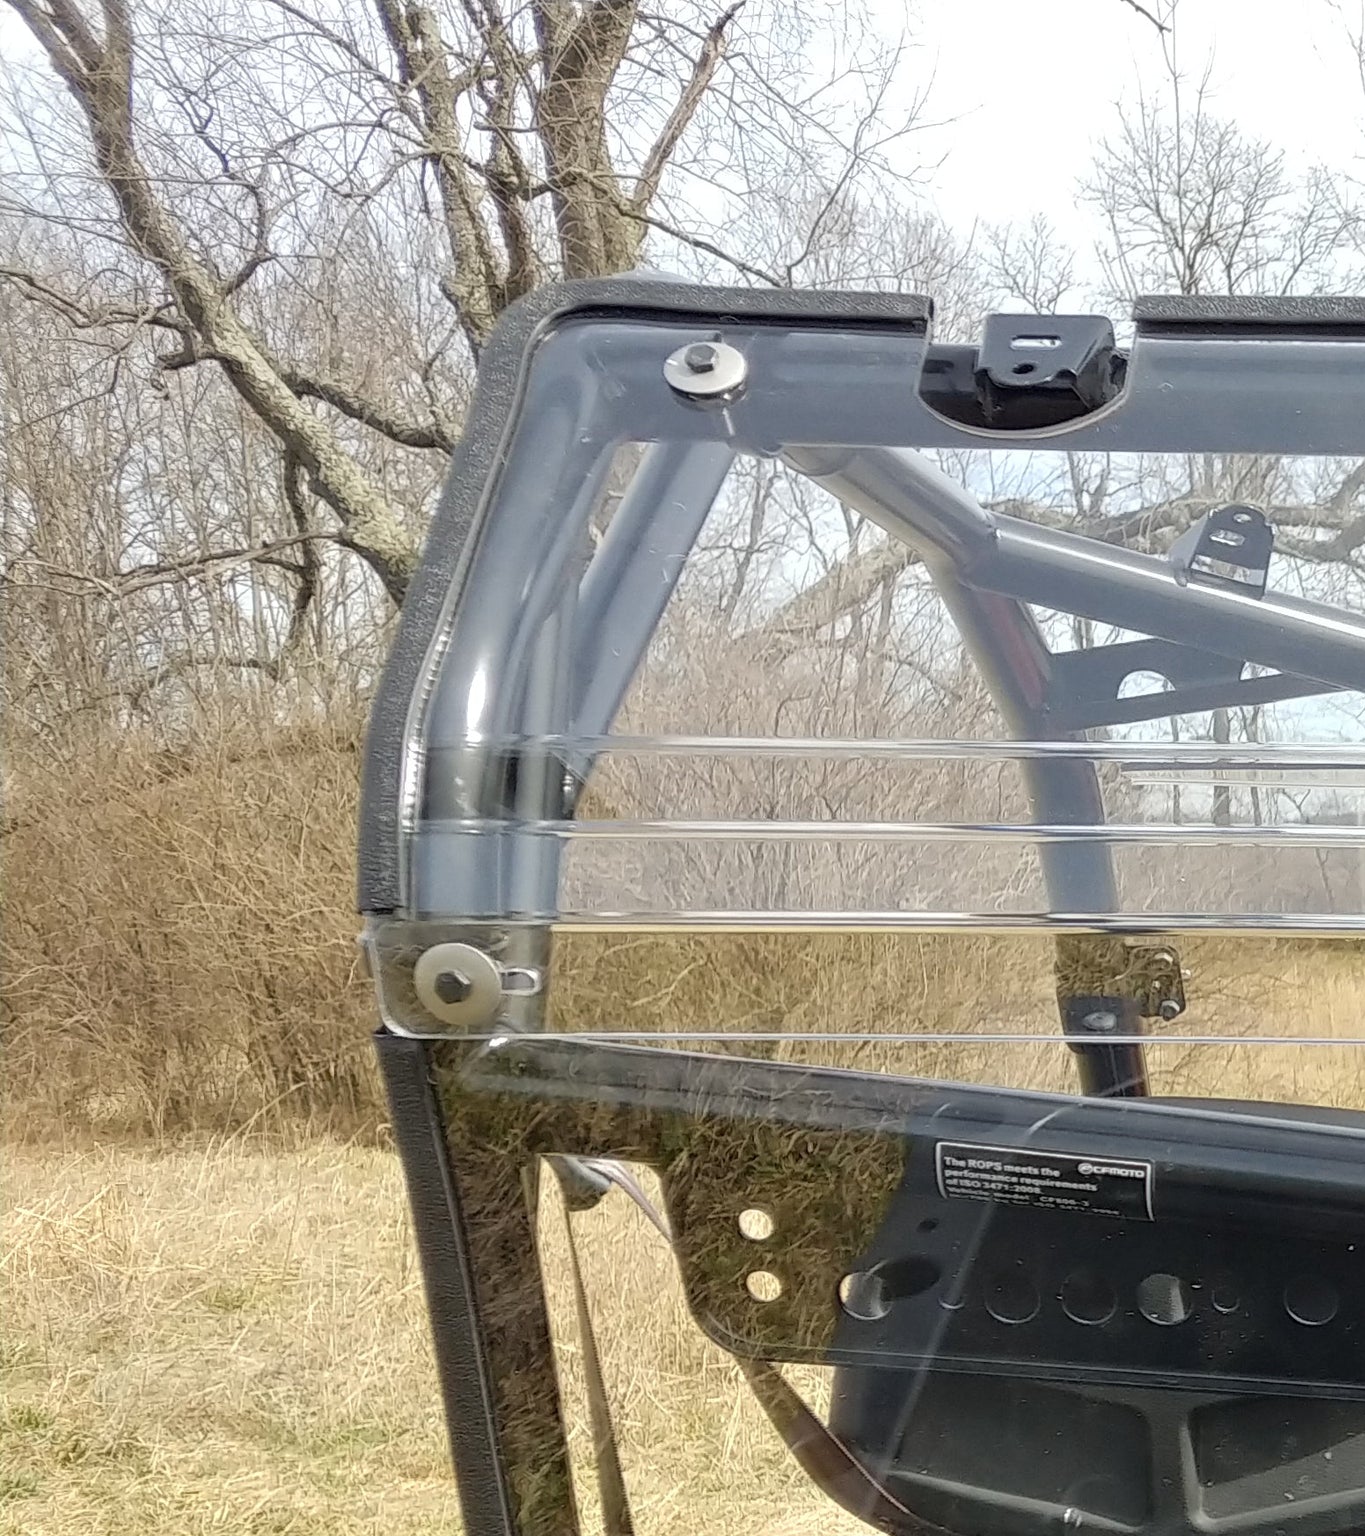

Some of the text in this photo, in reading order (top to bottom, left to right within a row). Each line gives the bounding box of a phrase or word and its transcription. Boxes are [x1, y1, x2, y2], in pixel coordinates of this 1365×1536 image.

[944, 1157, 1060, 1177] The ROPS meets the
[1093, 1166, 1145, 1178] CFMOTO
[944, 1169, 1098, 1192] performance requirements
[959, 1180, 981, 1188] ISO
